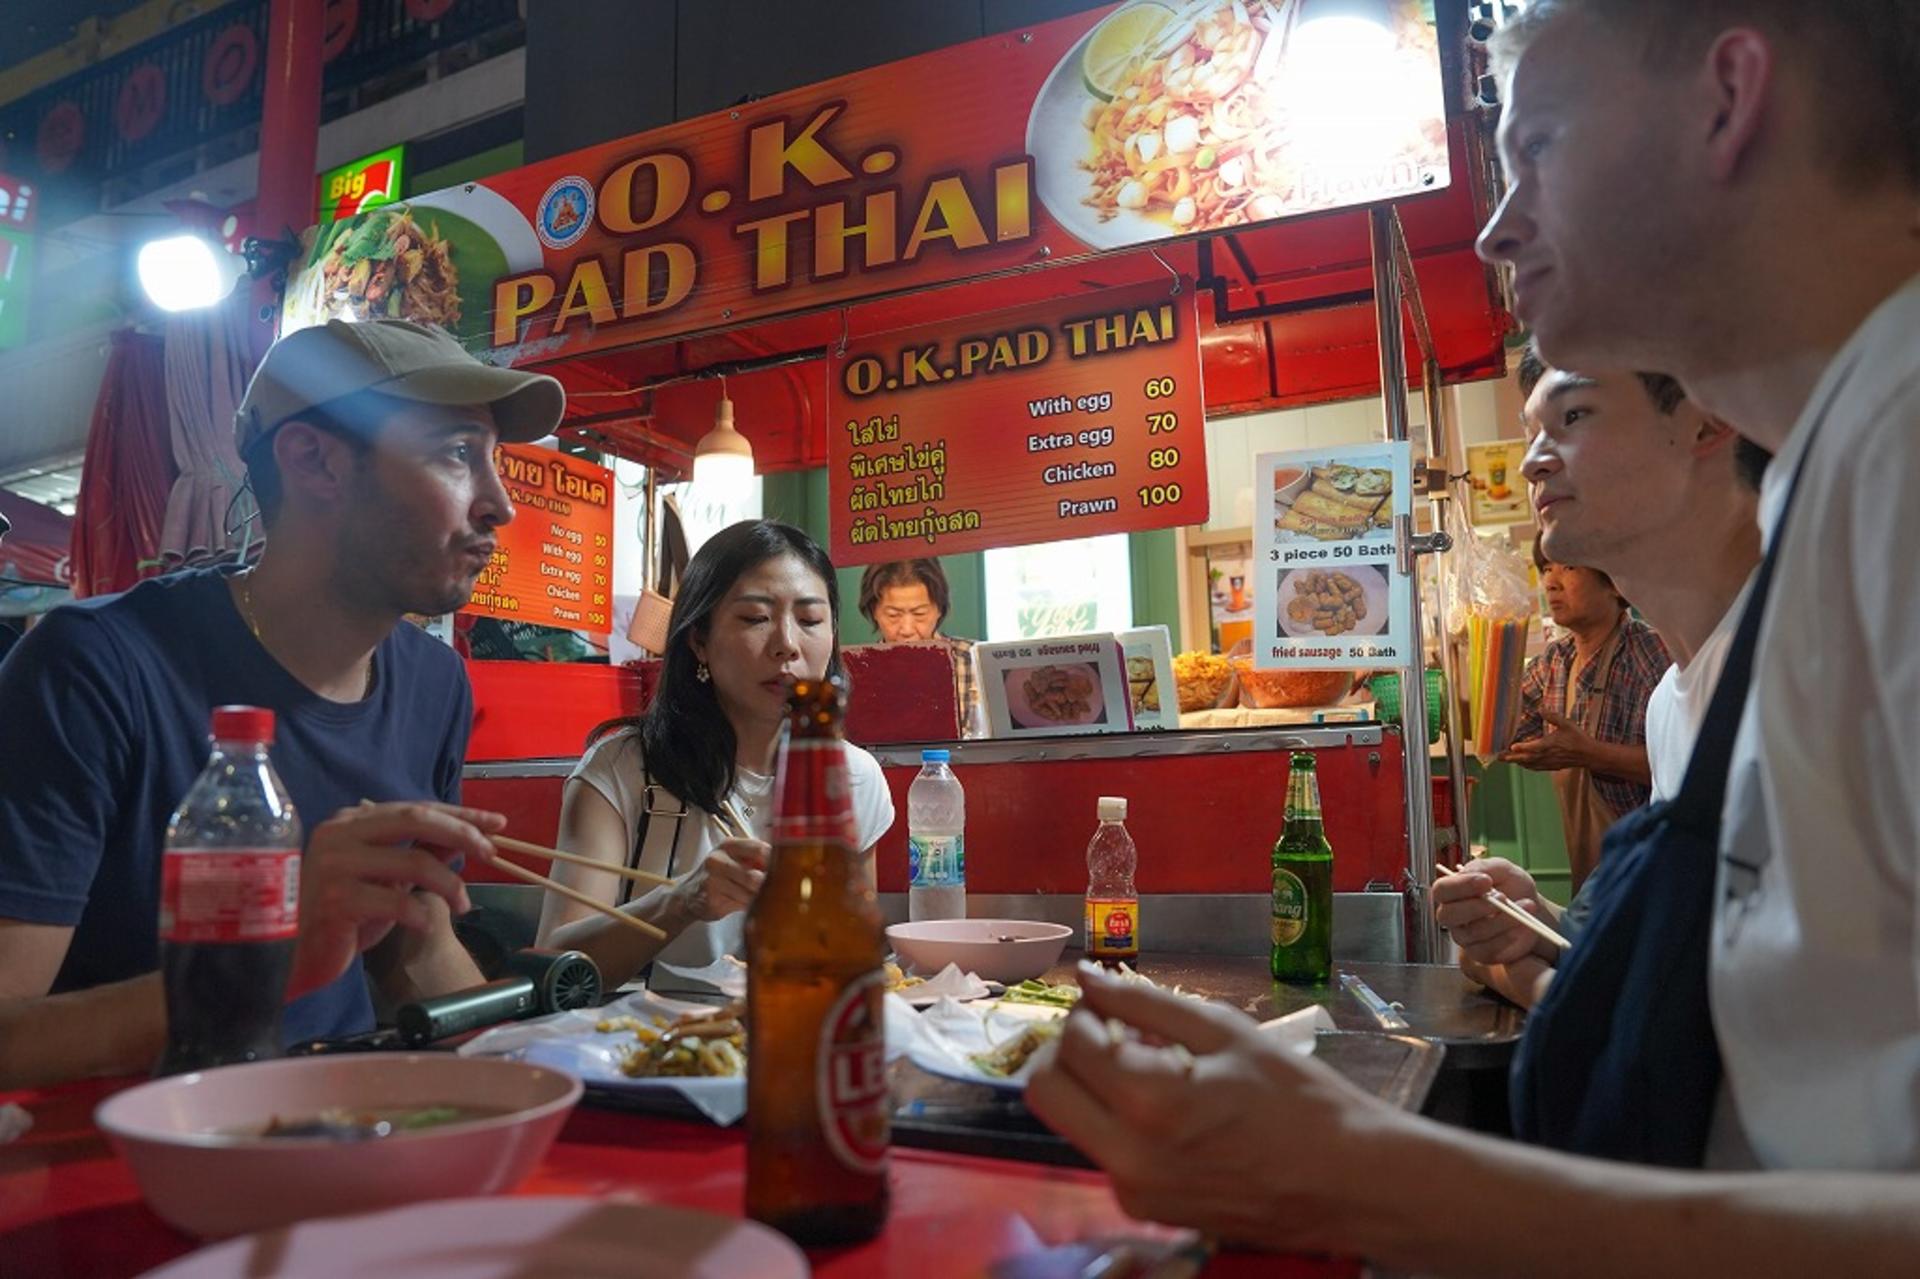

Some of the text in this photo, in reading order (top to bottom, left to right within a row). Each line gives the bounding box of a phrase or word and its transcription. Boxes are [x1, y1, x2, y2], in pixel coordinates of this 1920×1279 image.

[330, 171, 367, 200] Big
[598, 104, 897, 234] O.K.
[493, 242, 698, 347] PAD
[736, 161, 1032, 290] THAI
[1064, 305, 1175, 356] THAI
[1028, 377, 1175, 418] With egg 60
[847, 415, 899, 446] ใส่ไข่
[1028, 413, 1177, 453] Extra egg 70
[849, 441, 946, 478] พิเศษไข่คู่
[1043, 448, 1179, 484] Chicken 80
[550, 463, 607, 505] โอเค
[850, 476, 943, 511] ผัดไทยไก่
[1059, 485, 1181, 518] Prawn 100
[550, 524, 565, 537] No
[850, 508, 980, 543] ผัดไทยกุ้งสด
[543, 543, 565, 557] With
[1269, 544, 1397, 563] 3 piece 50 Bath
[547, 585, 581, 600] Chicken
[594, 574, 607, 586] 70
[1272, 646, 1296, 659] fried
[1299, 646, 1343, 660] sausage
[1349, 647, 1364, 658] 50
